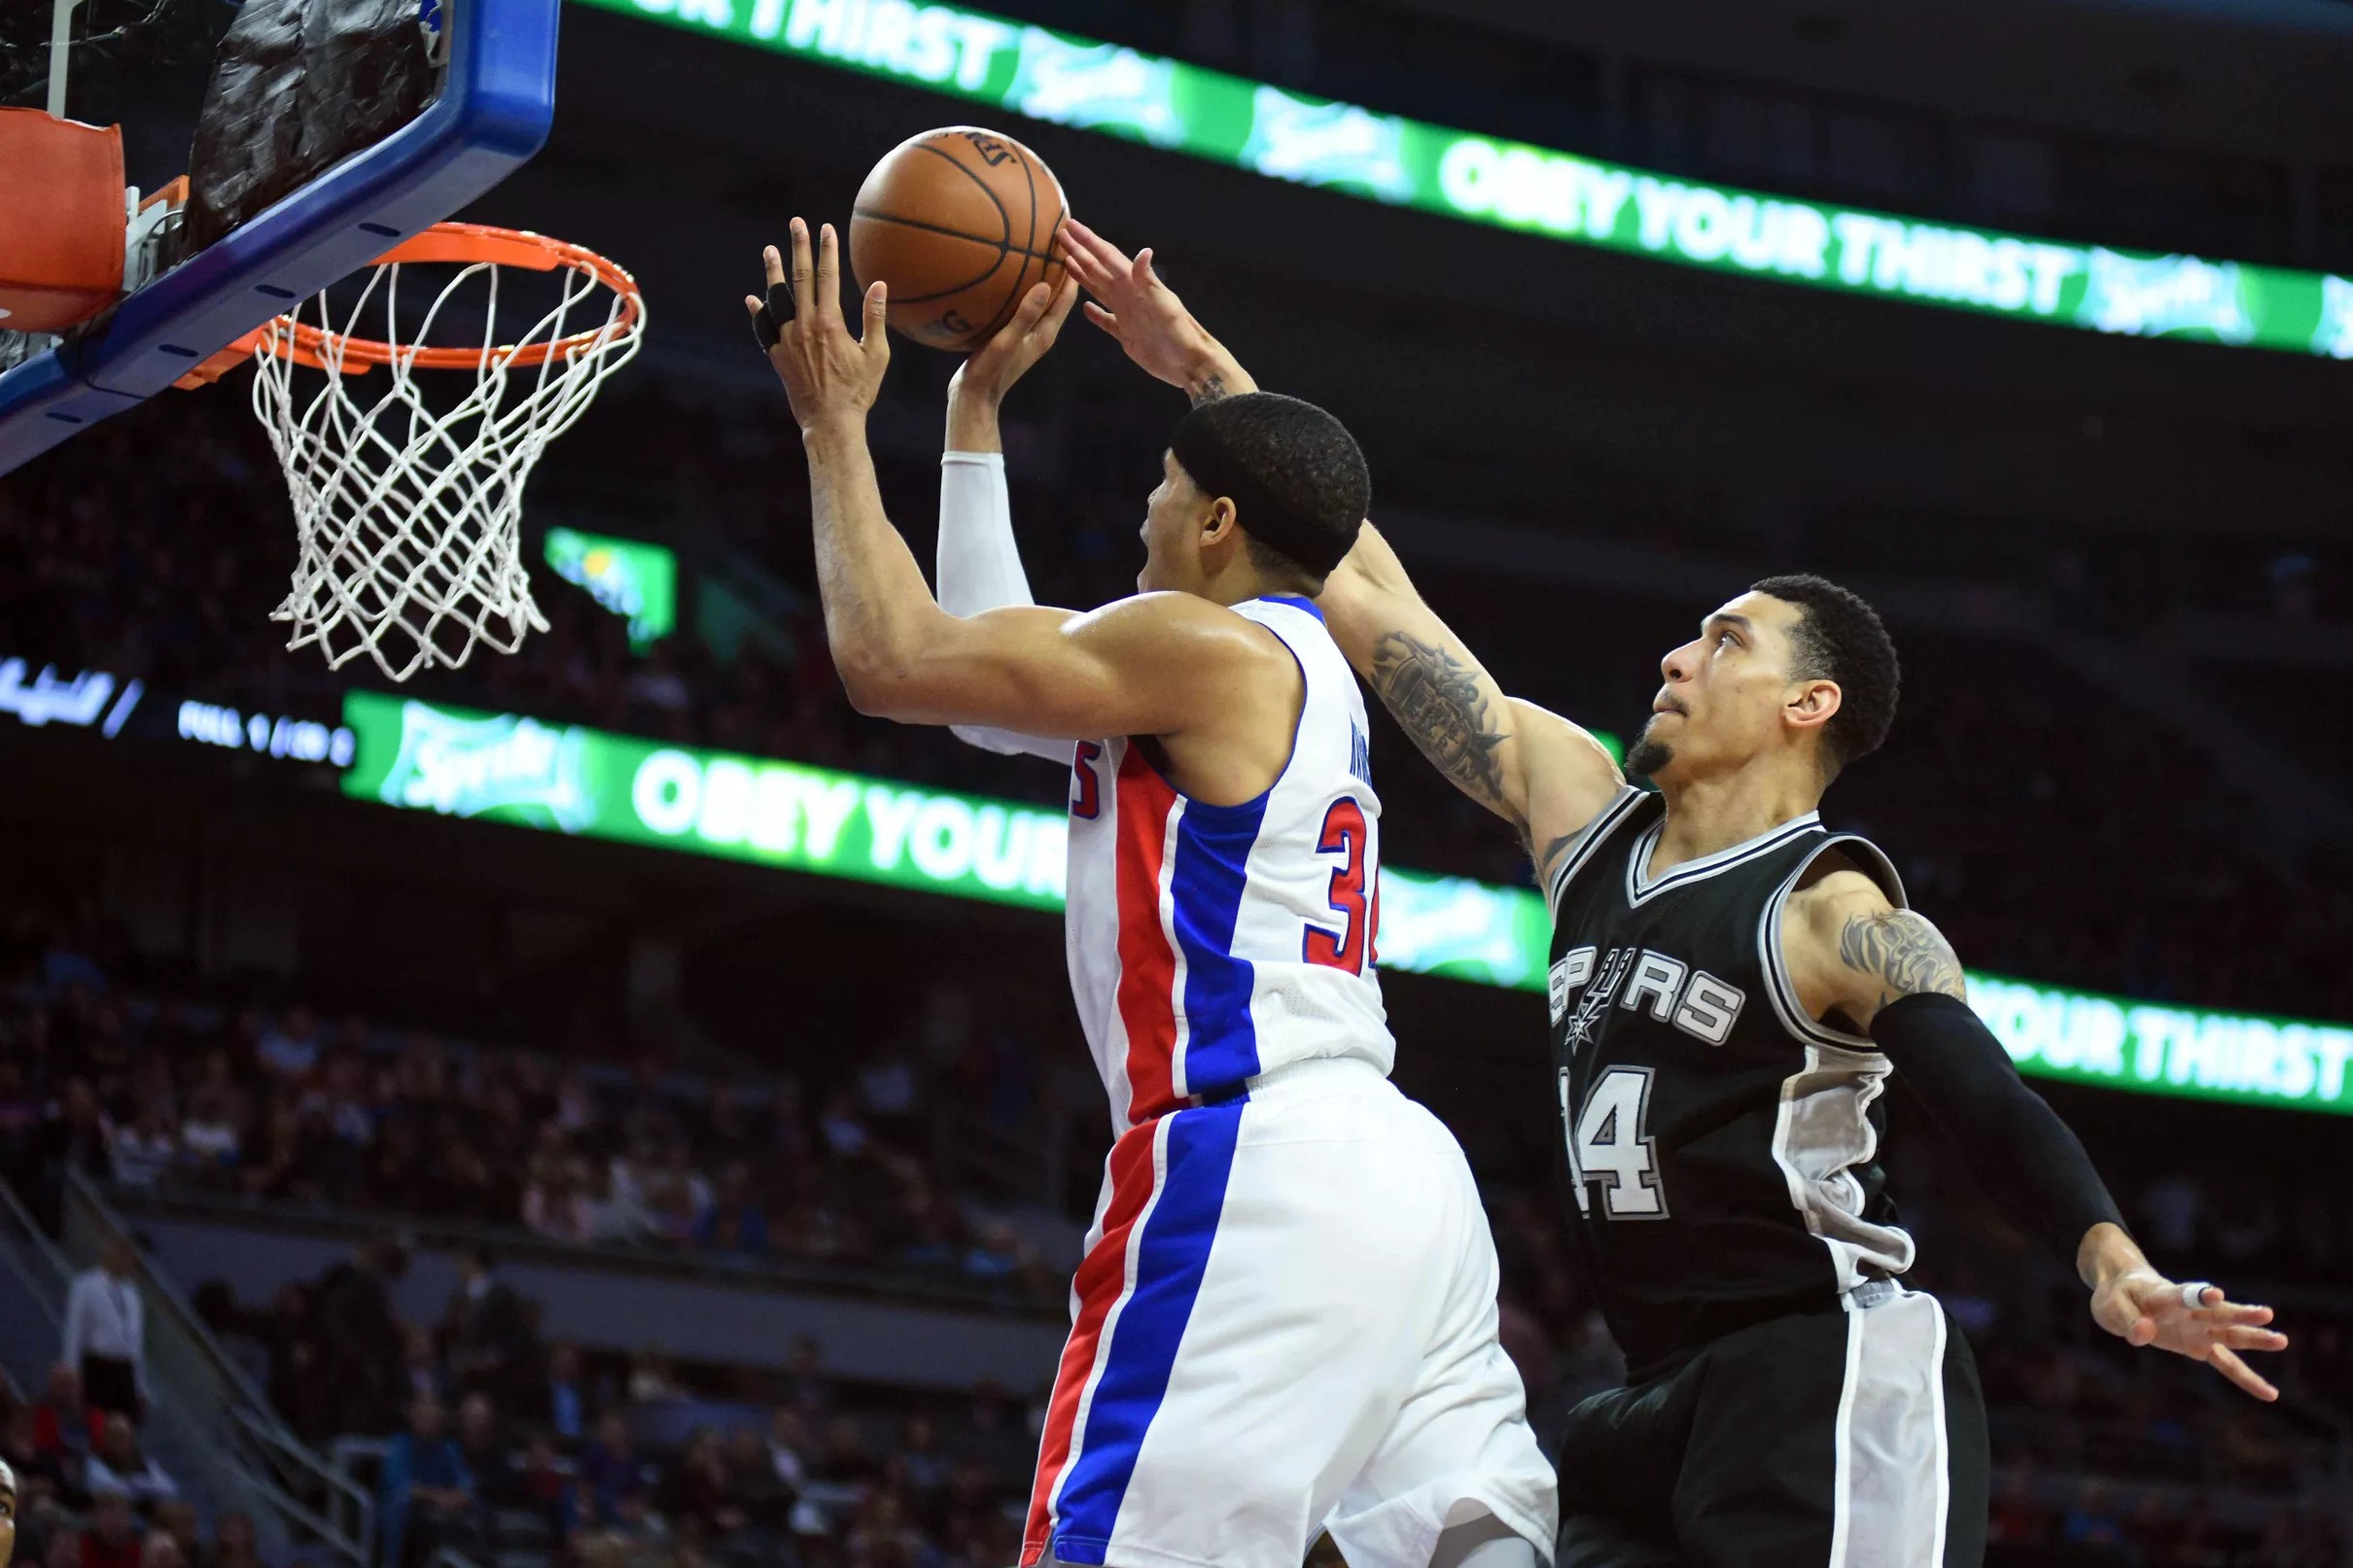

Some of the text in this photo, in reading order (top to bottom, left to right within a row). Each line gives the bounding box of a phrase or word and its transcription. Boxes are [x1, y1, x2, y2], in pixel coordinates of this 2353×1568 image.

[1437, 137, 1635, 240] OBEY
[1637, 176, 1828, 276] YOUR
[1834, 212, 2079, 314] THIRST
[631, 749, 859, 862] OBEY
[863, 784, 1068, 902] YOUR
[2127, 1006, 2353, 1100] THIRST
